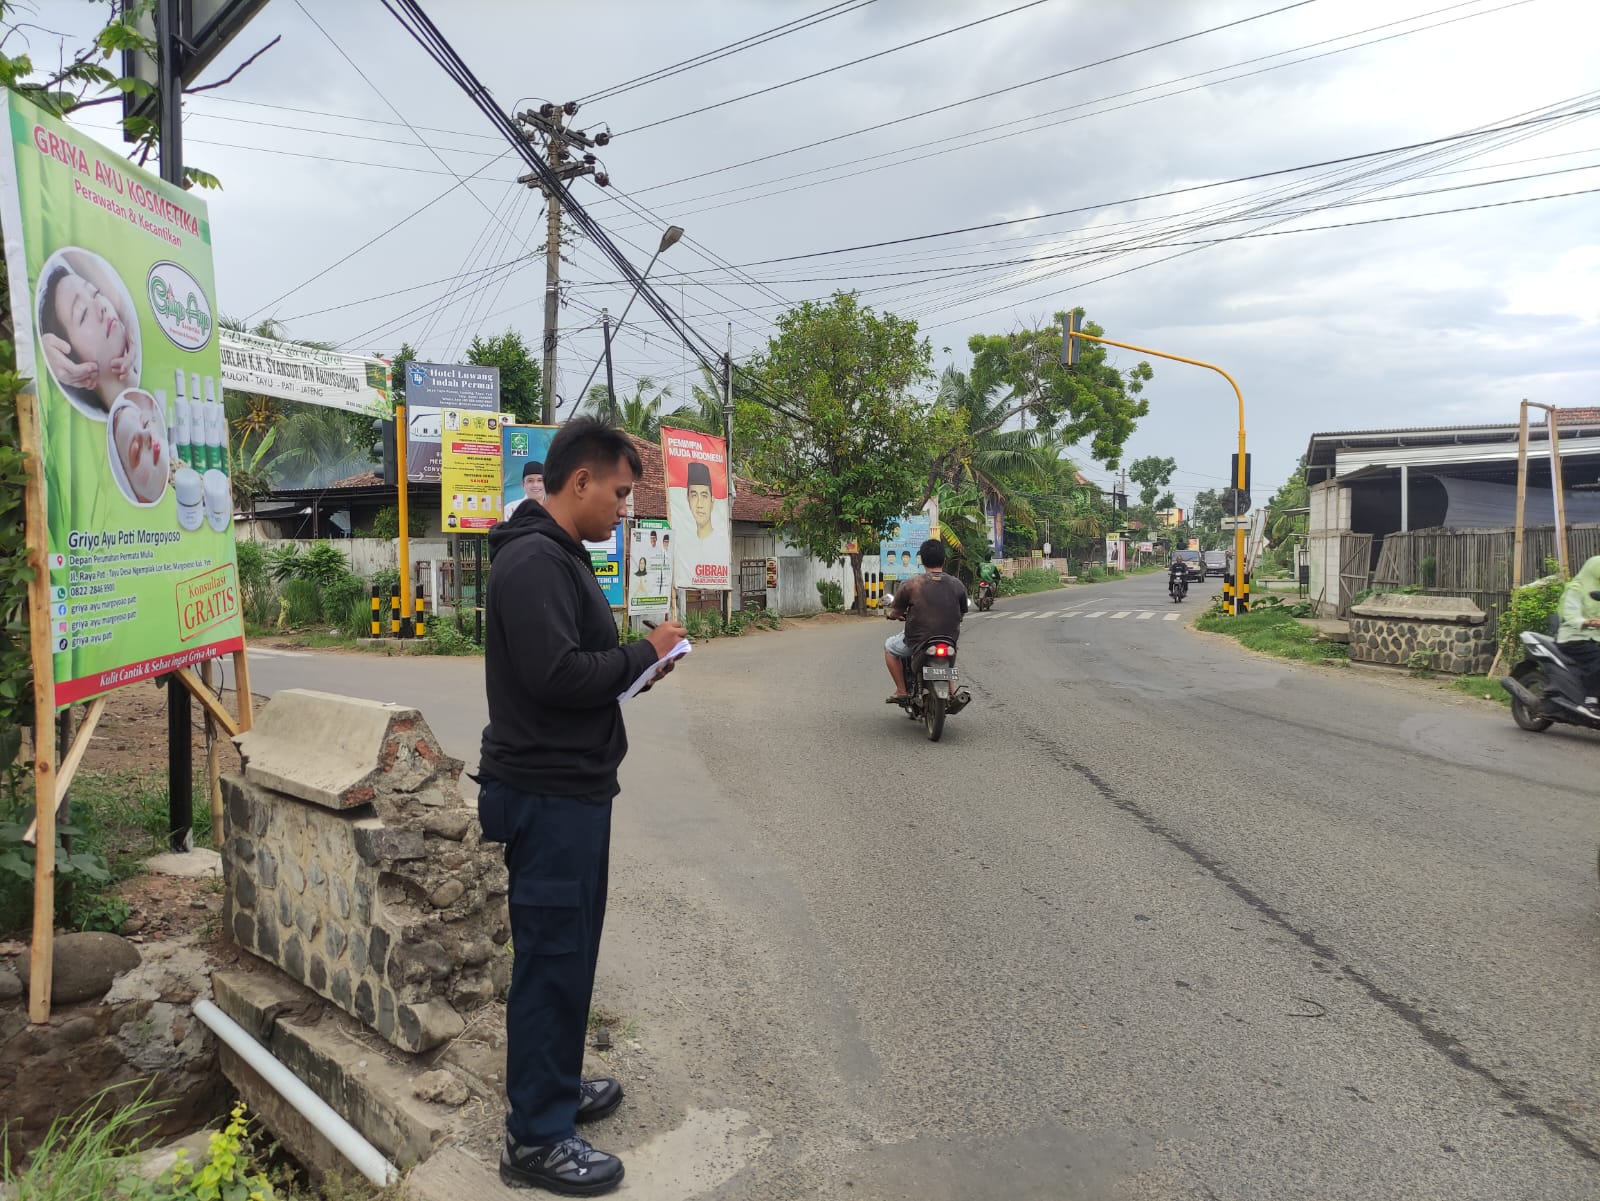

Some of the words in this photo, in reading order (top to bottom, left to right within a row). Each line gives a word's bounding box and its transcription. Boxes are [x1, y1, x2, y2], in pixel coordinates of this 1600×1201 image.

[34, 126, 90, 176] GRIYA
[95, 160, 124, 195] AYU
[127, 178, 199, 236] KOSMETIKA
[74, 179, 127, 218] Perawatan
[129, 209, 137, 225] &
[139, 215, 182, 248] Kecantikan
[303, 365, 315, 383] BIN
[430, 369, 455, 378] Hotel
[458, 371, 494, 382] Luwang
[222, 371, 248, 382] KULON
[256, 376, 273, 388] TAYU
[281, 381, 295, 392] PATI
[301, 386, 324, 397] JATENG
[432, 378, 458, 387] Indah
[461, 380, 494, 390] Permai
[668, 438, 703, 450] PEMIMPIN
[669, 448, 691, 458] MUDA
[68, 532, 100, 551] Griya
[101, 531, 116, 549] Ayu
[118, 530, 135, 545] Pati
[137, 530, 181, 546] Margoyoso
[69, 555, 92, 567] Depan
[93, 554, 119, 565] Perumahan
[120, 551, 139, 561] Permata
[70, 572, 78, 581] Jl.
[79, 571, 96, 583] Raya
[120, 567, 132, 576] Desa
[695, 564, 728, 577] GIBRAN
[70, 586, 87, 597] 0822
[188, 571, 226, 599] Konsultasi
[71, 603, 88, 615] griya
[90, 603, 100, 612] ayu
[127, 596, 137, 605] pati
[184, 586, 234, 630] GRATIS
[71, 620, 89, 631] griya
[90, 619, 101, 628] ayu
[127, 611, 137, 620] pati
[71, 636, 89, 648] griya
[90, 635, 101, 643] ayu
[102, 631, 113, 642] pati
[99, 671, 119, 687] Kulit
[119, 665, 143, 681] Cantik
[144, 664, 150, 674] &
[151, 659, 171, 672] Sehat
[171, 655, 188, 668] ingat
[188, 651, 205, 664] Griya
[206, 647, 217, 657] Ayu
